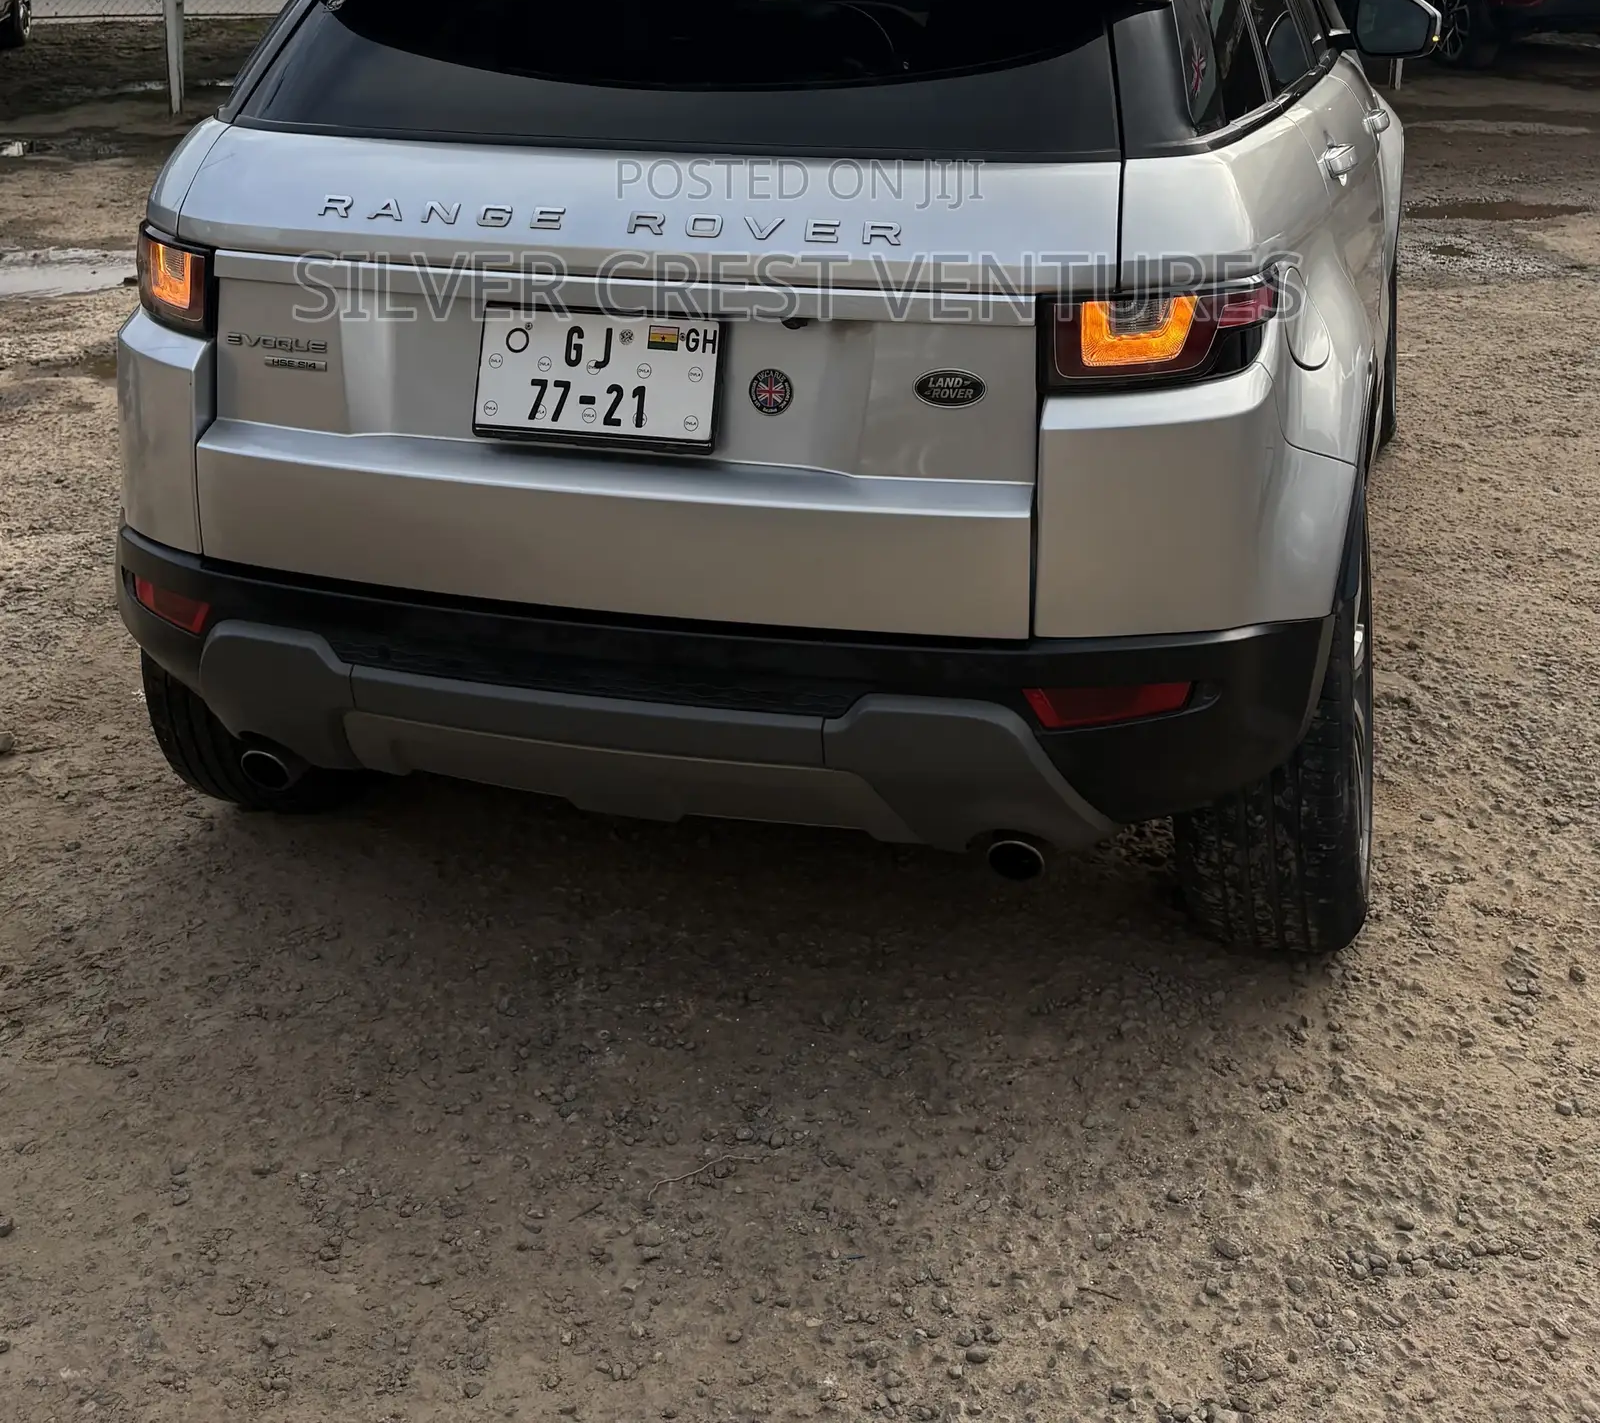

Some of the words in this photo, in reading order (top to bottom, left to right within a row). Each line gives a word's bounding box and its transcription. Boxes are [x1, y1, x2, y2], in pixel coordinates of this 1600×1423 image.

[318, 194, 566, 230] RANGE
[626, 210, 902, 246] ROVER
[226, 332, 328, 353] EVOQUE
[685, 328, 718, 354] GH
[271, 358, 296, 368] HSE
[928, 378, 962, 388] LAND
[528, 379, 646, 428] 77-21
[931, 389, 973, 399] ROVER
